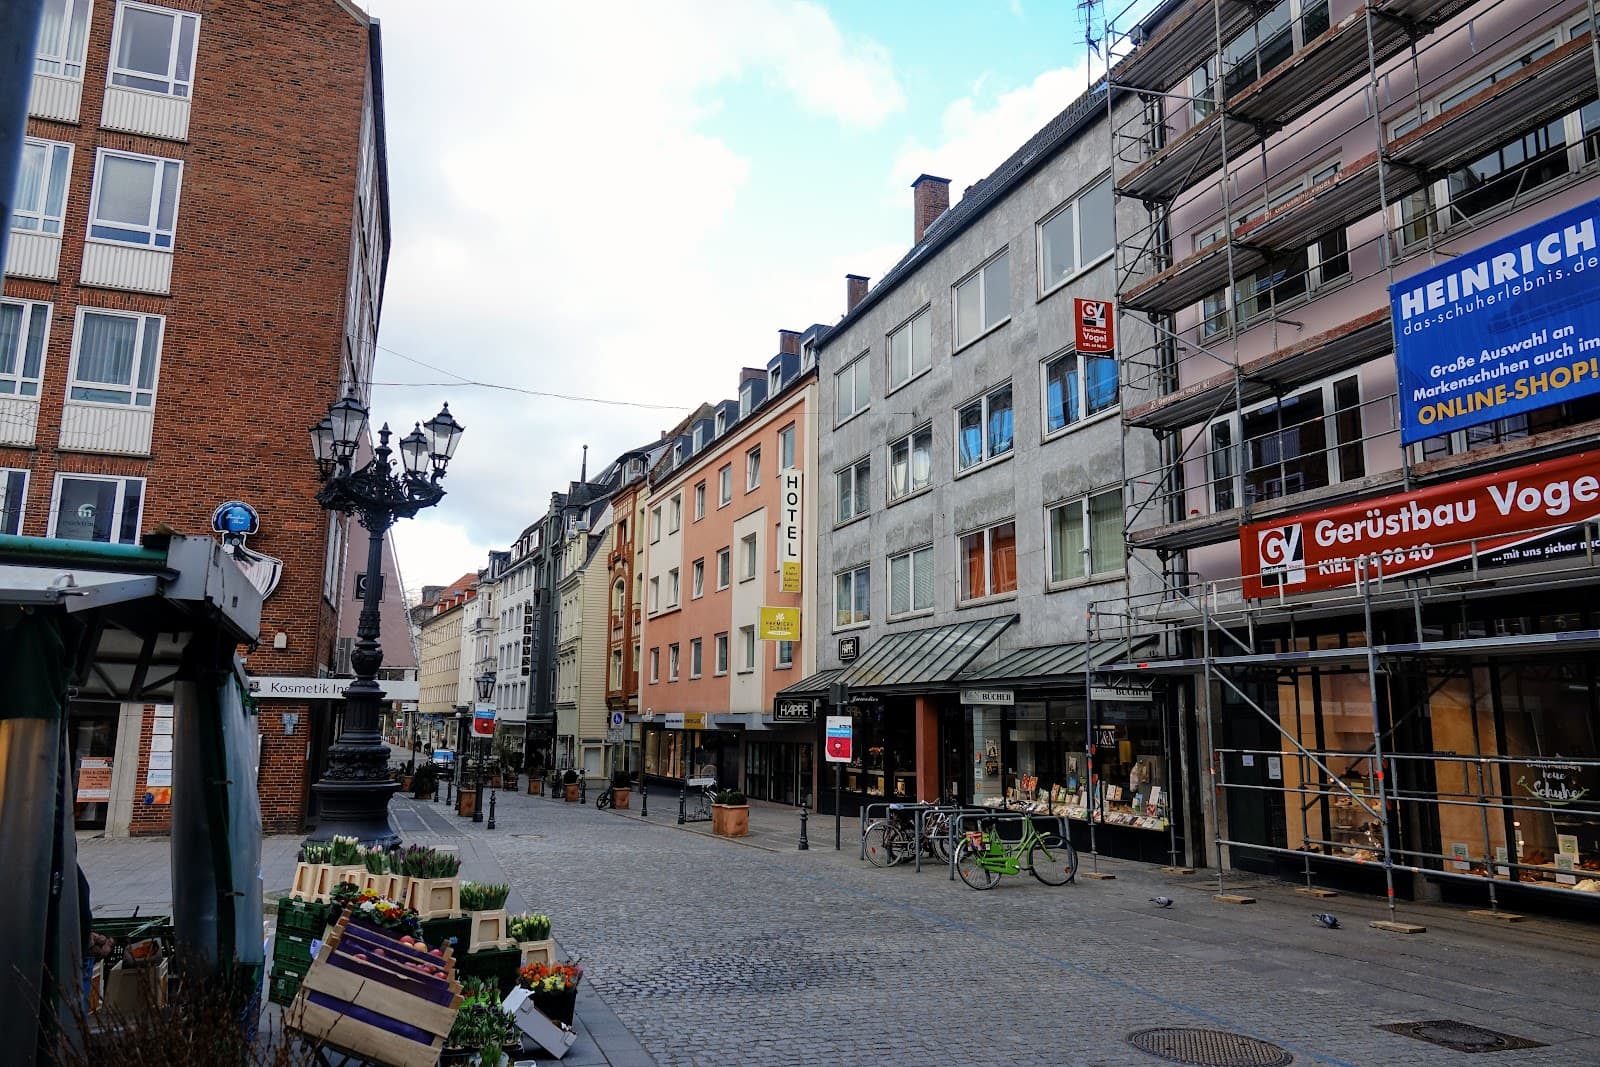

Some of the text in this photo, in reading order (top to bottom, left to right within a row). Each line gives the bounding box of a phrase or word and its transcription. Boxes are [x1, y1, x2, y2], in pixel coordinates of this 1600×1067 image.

[1401, 218, 1596, 320] HEINRICH
[1404, 256, 1598, 335] das-schuherlebnis.de
[1083, 332, 1107, 343] Vogel
[1430, 325, 1574, 378] Große Auswahl an
[1413, 337, 1600, 401] Markenschuhen auch im
[1418, 358, 1599, 425] ONLINE-SHOP!
[787, 475, 798, 557] HOTEL
[1315, 476, 1600, 547] Gerüstbau Voge
[1318, 557, 1351, 575] KIEL
[1382, 548, 1405, 565] 98
[1409, 543, 1434, 560] 40
[1522, 548, 1541, 557] uns
[1544, 542, 1577, 554] sicher
[271, 682, 329, 694] Kosmetik
[780, 704, 809, 716] HAPPE
[1534, 780, 1579, 800] Schuhe
